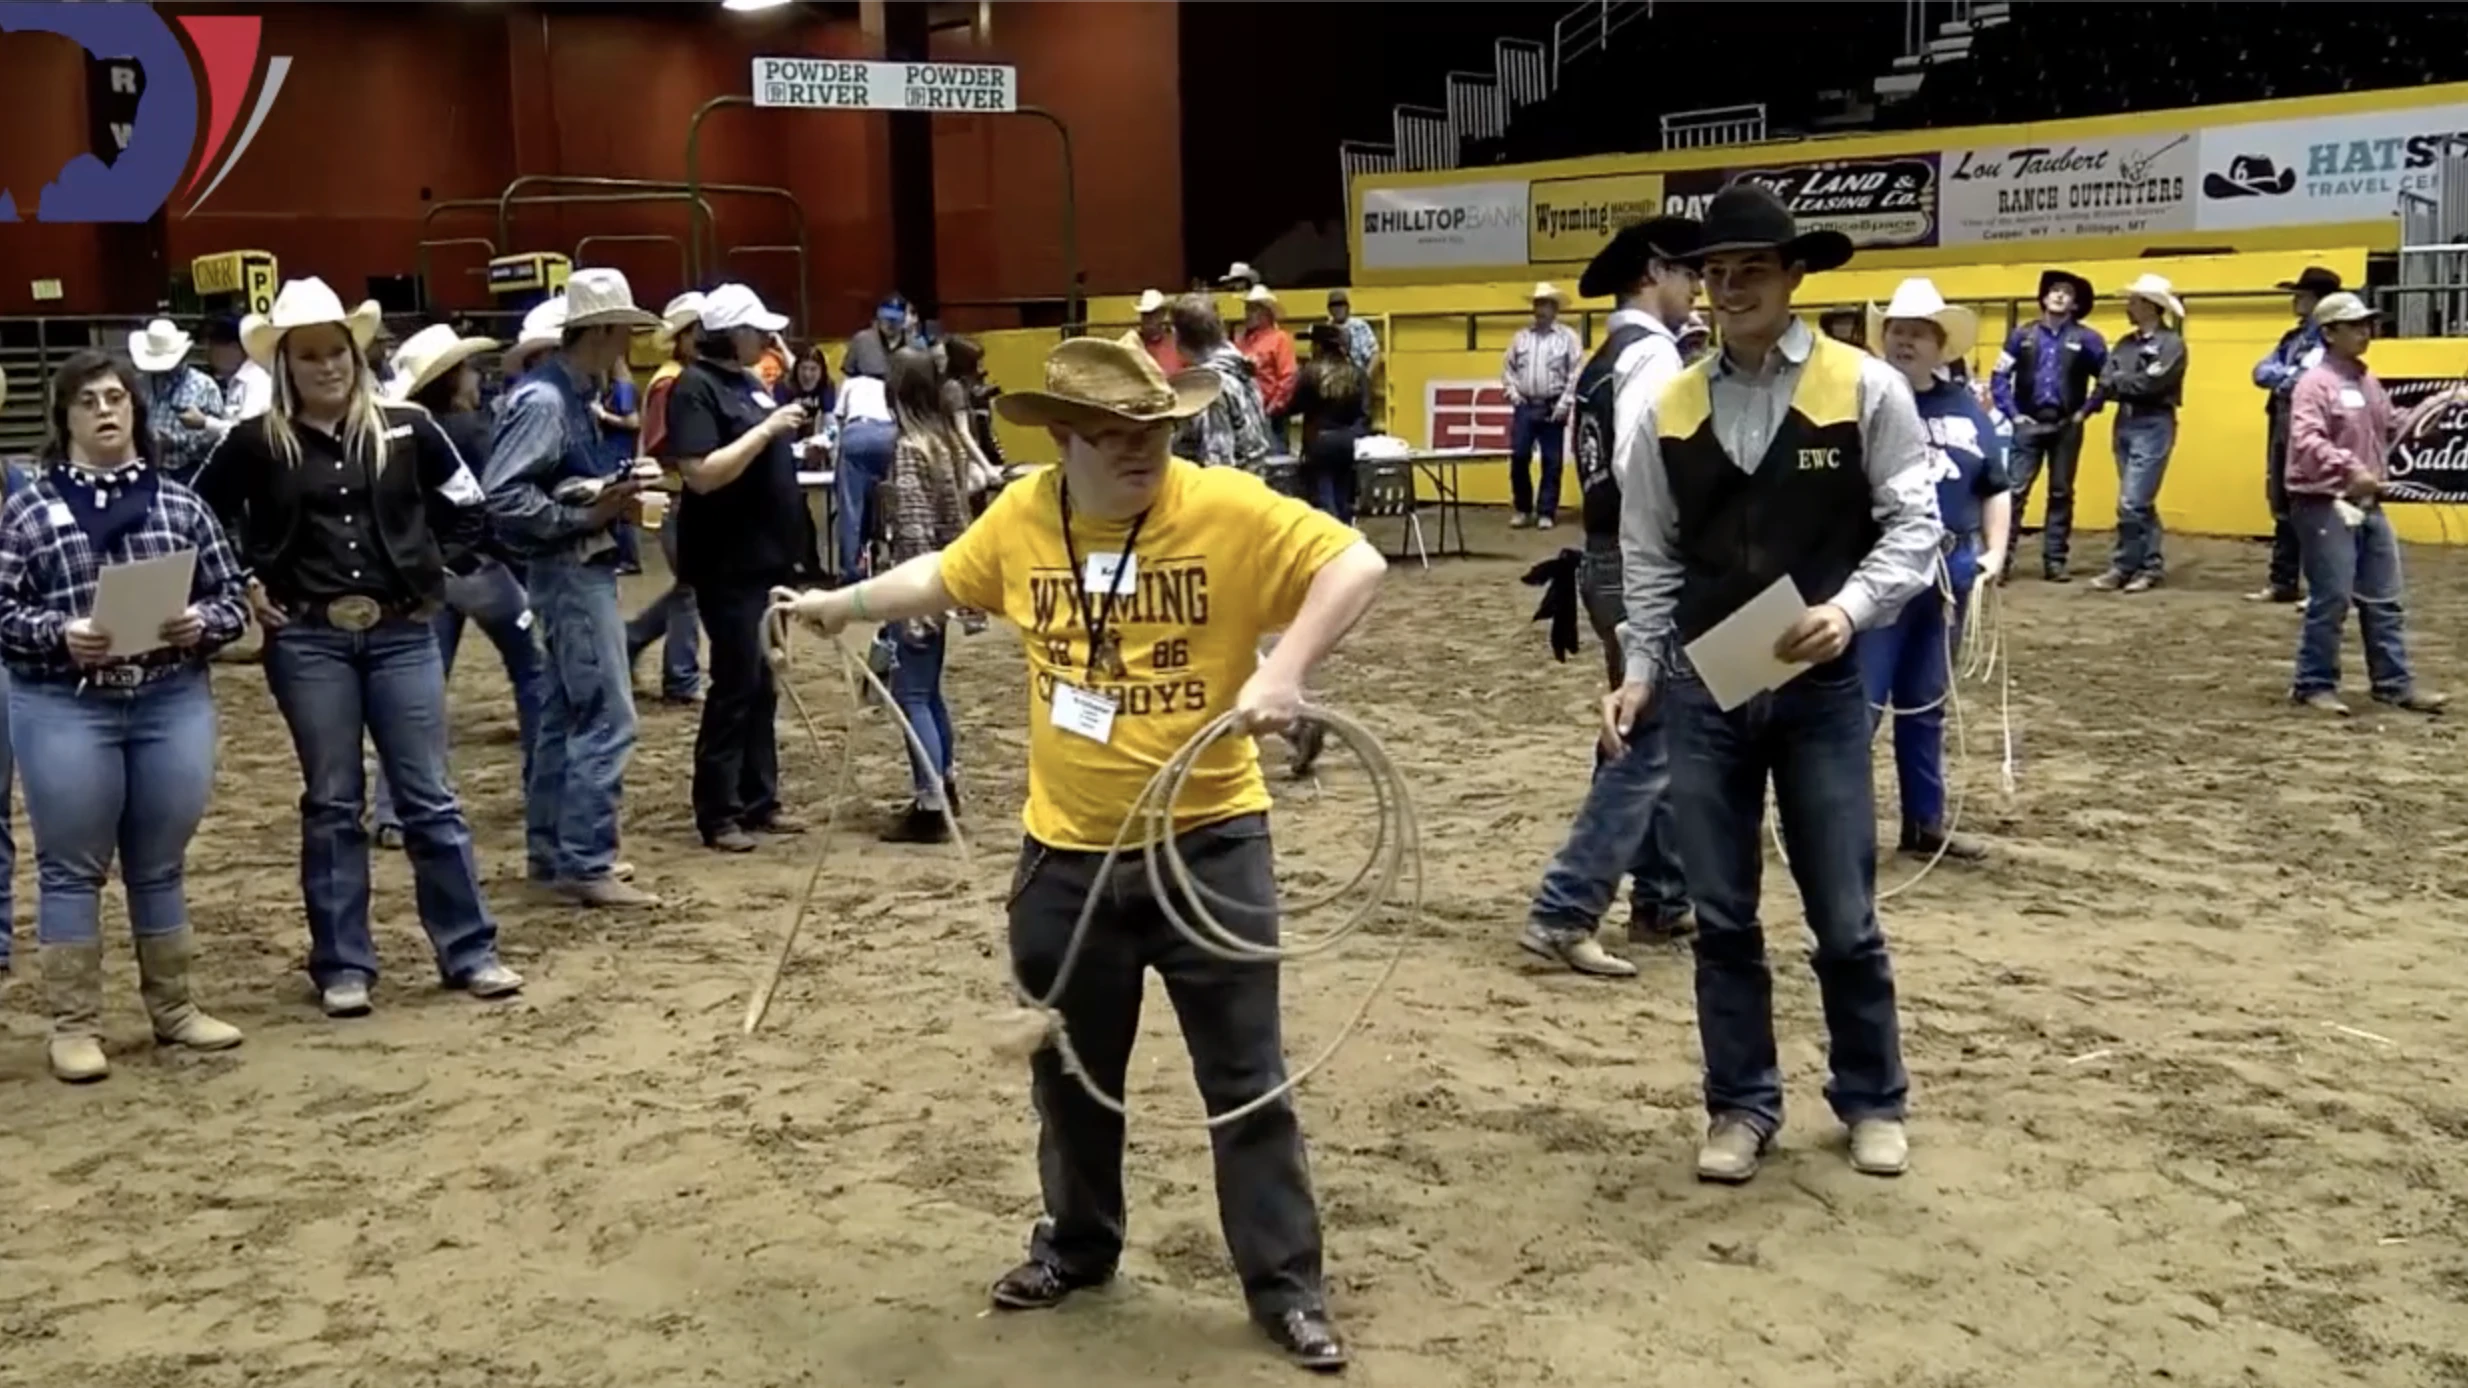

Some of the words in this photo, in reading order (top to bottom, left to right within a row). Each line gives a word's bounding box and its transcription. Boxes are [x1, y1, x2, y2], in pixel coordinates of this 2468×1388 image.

[765, 61, 869, 82] POWDER
[905, 66, 1005, 87] POWDER
[788, 83, 869, 105] RIVER
[928, 87, 1005, 109] RIVER
[1950, 151, 2002, 181] Lou
[2007, 146, 2109, 180] Taubert
[1800, 172, 1889, 195] LAND
[1892, 175, 1916, 189] &
[2306, 178, 2391, 198] TRAVEL
[1788, 195, 1874, 212] LEASING
[1997, 186, 2059, 214] RANCH
[2069, 176, 2184, 208] OUTFITTERS
[1535, 201, 1609, 239] Wyoming
[2128, 219, 2147, 231] MT
[1798, 448, 1841, 470] EWC
[1152, 638, 1189, 669] 86
[1037, 670, 1207, 716] CBOYS
